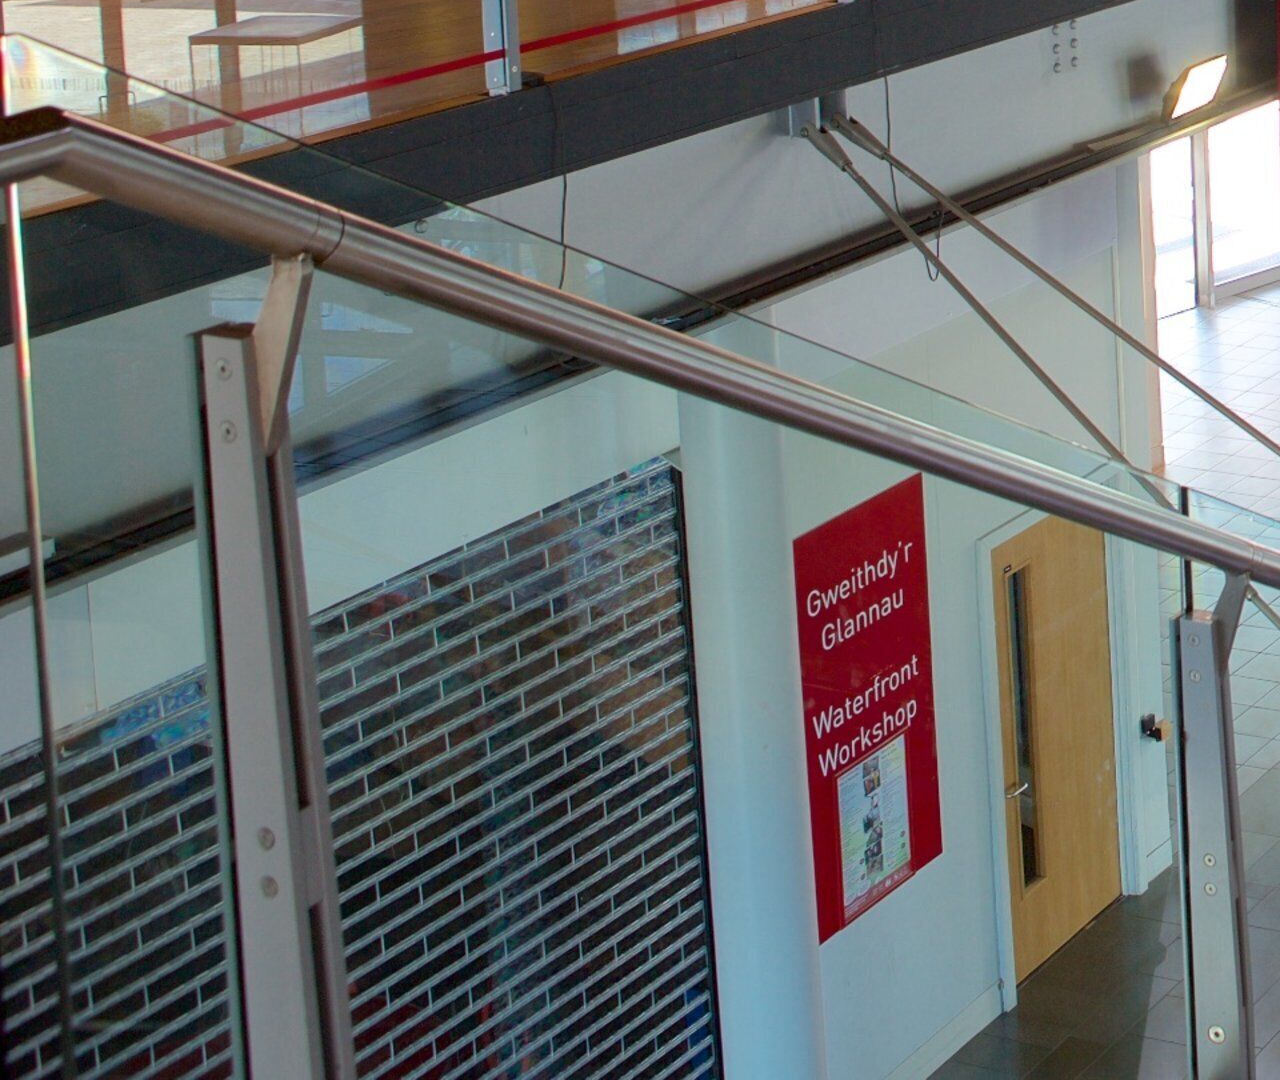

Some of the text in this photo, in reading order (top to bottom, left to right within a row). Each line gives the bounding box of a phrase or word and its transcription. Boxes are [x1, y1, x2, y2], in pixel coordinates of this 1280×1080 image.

[806, 540, 913, 617] Gweithdy'r
[822, 588, 904, 650] Glannau
[812, 654, 919, 739] Waterfront
[818, 699, 917, 777] Workshop
